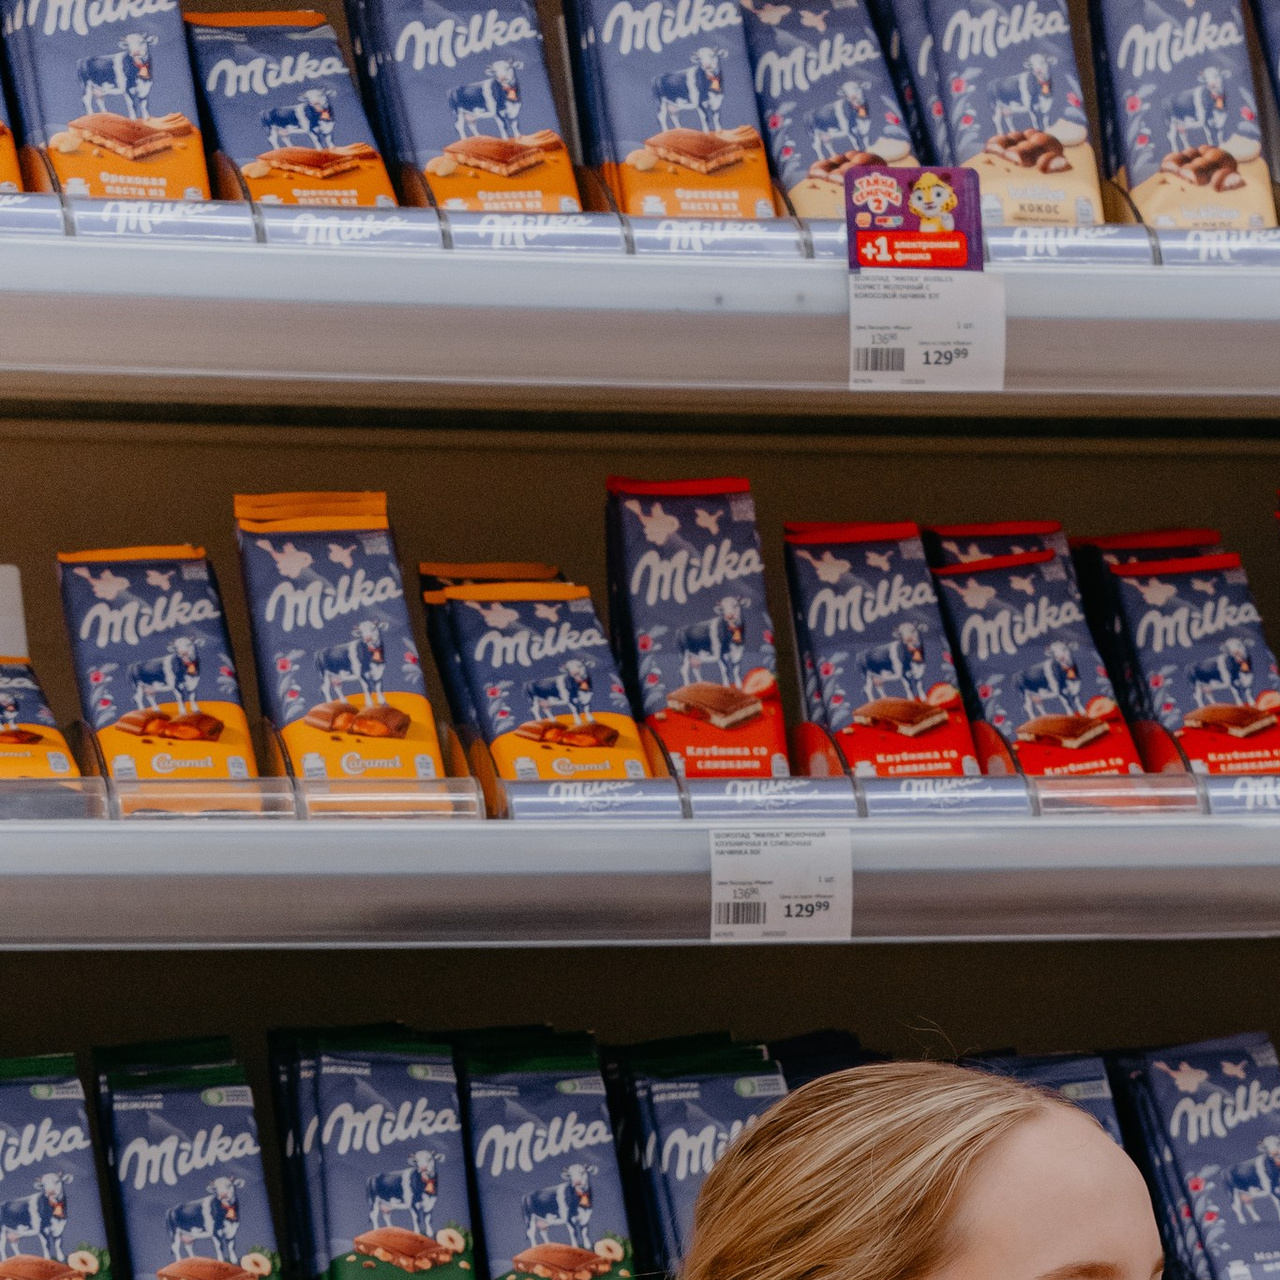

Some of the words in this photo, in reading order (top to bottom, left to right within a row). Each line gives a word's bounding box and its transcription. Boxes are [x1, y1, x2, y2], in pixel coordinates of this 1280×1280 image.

[395, 8, 541, 70] Milka
[601, 0, 742, 54] Milka
[942, 0, 1072, 60] Milka
[1118, 12, 1244, 78] Milka
[206, 52, 352, 97] Milka
[755, 34, 880, 97] Milka
[100, 202, 222, 232] Milka
[290, 213, 405, 241] Milka
[860, 236, 893, 262] +1
[629, 538, 766, 605] Milka
[78, 592, 220, 648] Milka
[264, 570, 402, 632] Milka
[807, 575, 939, 636] Milka
[960, 597, 1084, 660] Milka
[1136, 597, 1262, 652] Milka
[474, 623, 609, 668] Milka
[150, 750, 214, 775] Caramel
[340, 750, 403, 775] Caramel
[322, 1097, 461, 1155] Milka
[475, 1112, 612, 1176] Milka
[119, 1124, 260, 1190] Milka
